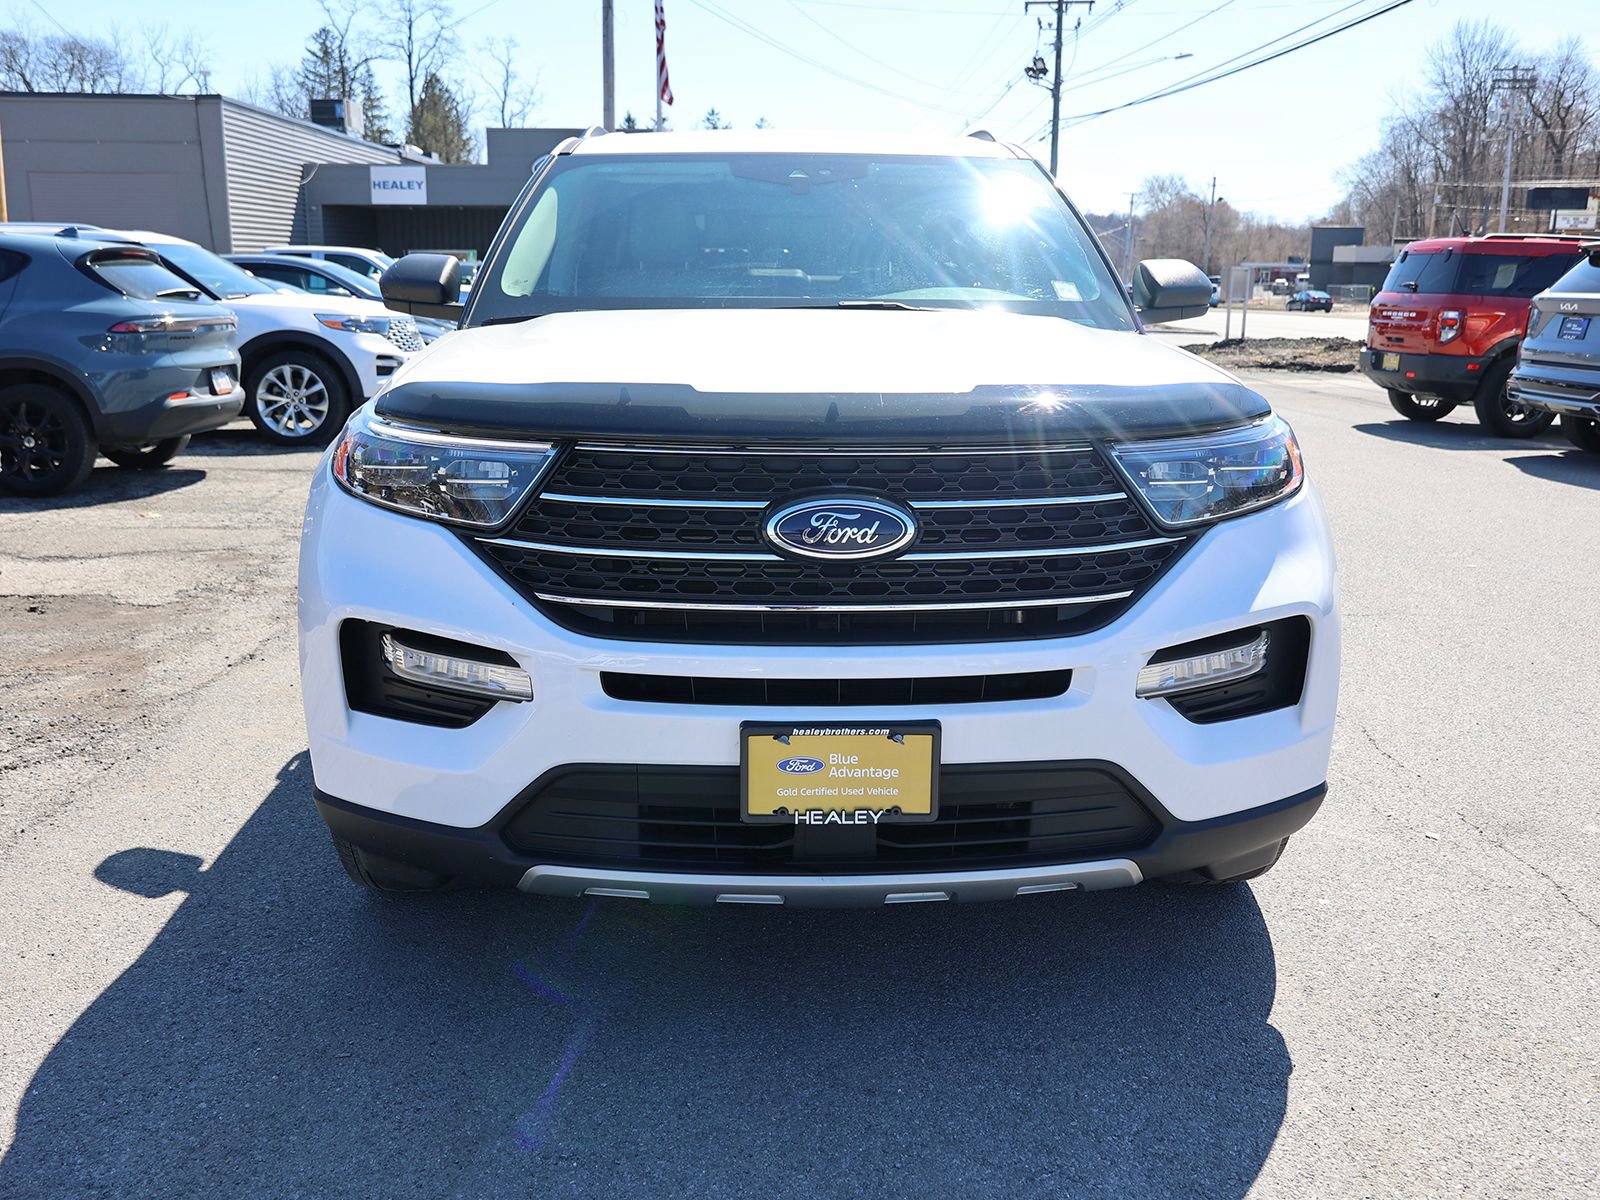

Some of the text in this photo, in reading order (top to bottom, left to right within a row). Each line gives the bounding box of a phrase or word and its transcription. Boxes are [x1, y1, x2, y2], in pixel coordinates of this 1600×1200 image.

[372, 180, 424, 190] HEALEY
[802, 511, 880, 544] Ford
[792, 728, 890, 737] healeybrothers.com
[829, 753, 859, 765] Blue
[786, 759, 816, 772] Ford
[828, 766, 899, 780] Advantage
[776, 787, 899, 797] Gold Certified Used Vehicle
[794, 810, 884, 825] HEALEY
